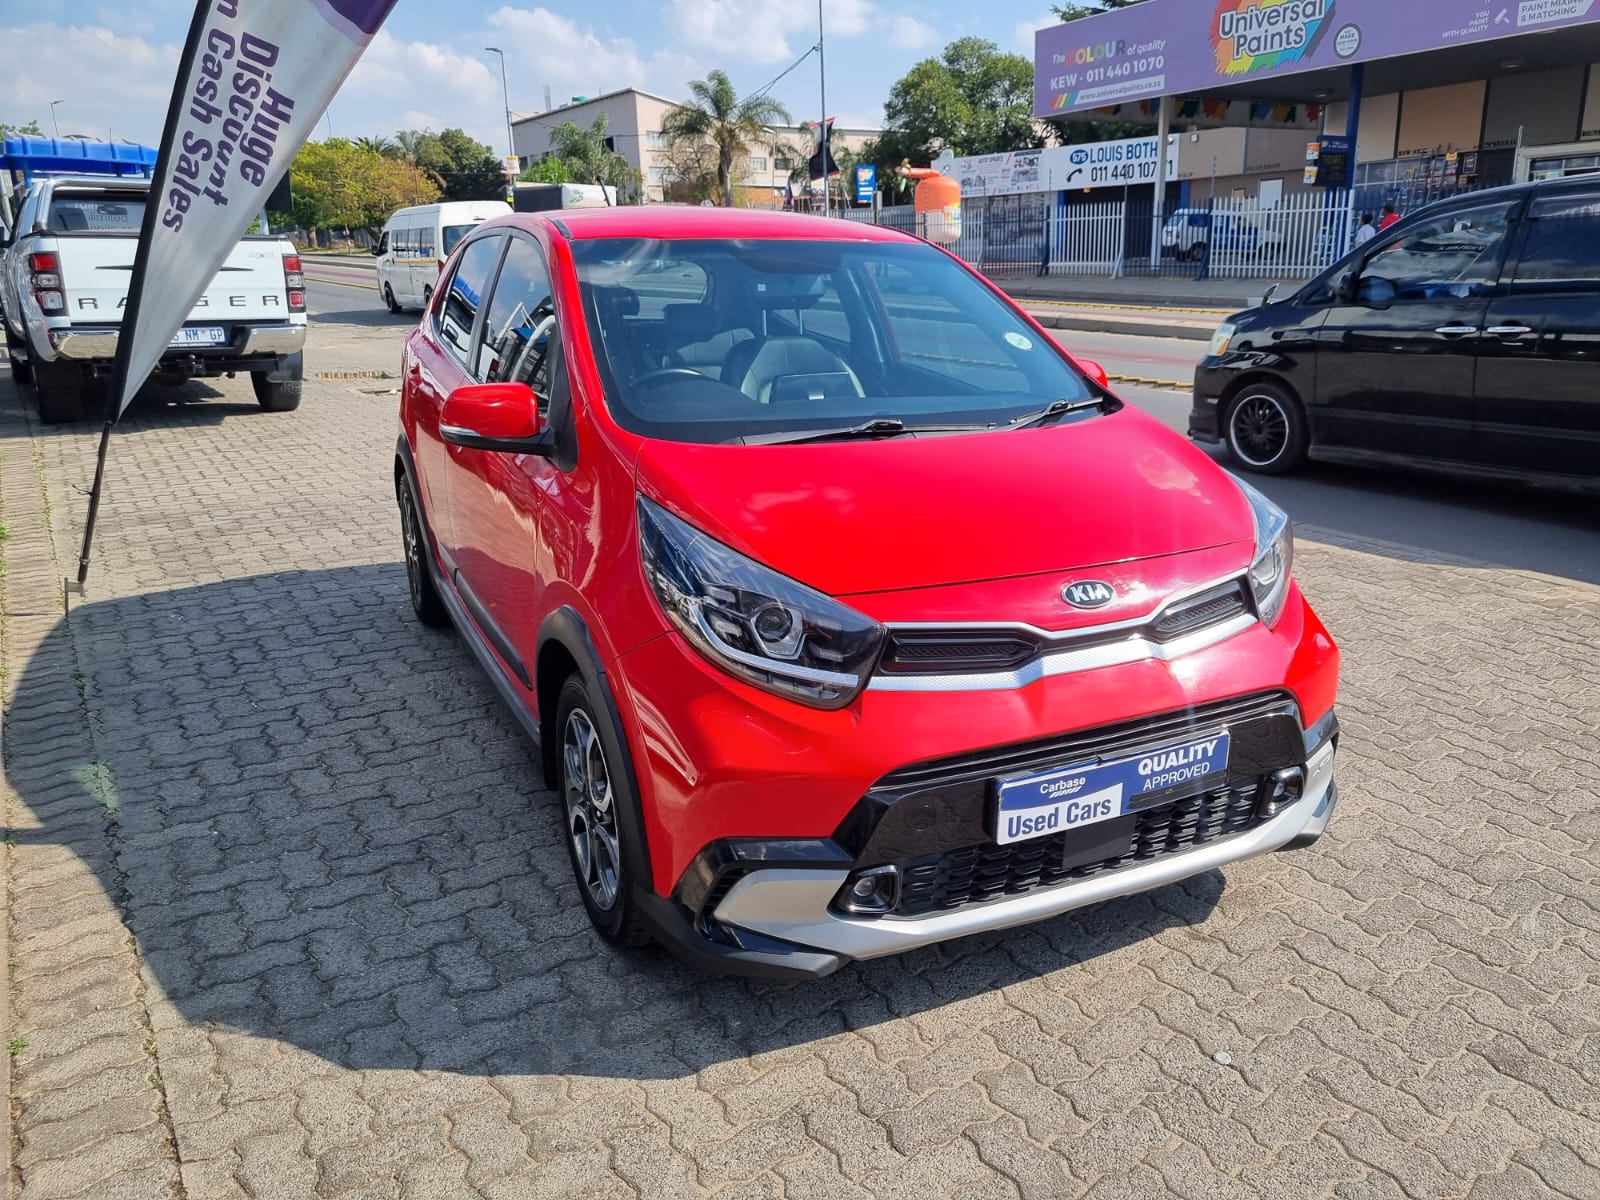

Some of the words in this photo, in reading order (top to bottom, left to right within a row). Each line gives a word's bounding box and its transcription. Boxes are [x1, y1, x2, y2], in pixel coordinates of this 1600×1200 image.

[1221, 0, 1324, 36] Universal
[1475, 10, 1490, 18] YOU
[1521, 1, 1549, 13] PAINT
[1528, 6, 1577, 21] MATCHING
[1460, 24, 1489, 35] QUALITY
[1469, 17, 1489, 26] PAINT
[1052, 54, 1065, 64] The
[1066, 40, 1125, 65] COLOUR
[1127, 43, 1137, 55] of
[1137, 39, 1166, 55] quality
[1236, 25, 1304, 57] Paints
[190, 28, 236, 125] Cash
[1050, 73, 1077, 91] KEW
[1086, 67, 1104, 82] 011
[1107, 62, 1130, 79] 440
[1133, 55, 1164, 73] 1070
[1080, 81, 1161, 99] www.universalpaints.co.za
[202, 31, 280, 206] Discount
[240, 87, 295, 188] Huge
[1072, 152, 1088, 163] 575
[1090, 145, 1123, 164] LOUIS
[162, 130, 213, 233] Sales
[1091, 165, 1108, 182] 011
[1111, 163, 1135, 180] 440
[1138, 160, 1173, 178] 1071
[210, 328, 223, 340] GP
[1070, 584, 1110, 602] KIA
[1138, 740, 1218, 776] QUALITY
[1040, 776, 1086, 795] Carbase
[1143, 763, 1211, 791] APPROVED
[1007, 807, 1059, 838] Used
[1066, 798, 1111, 825] Cars
